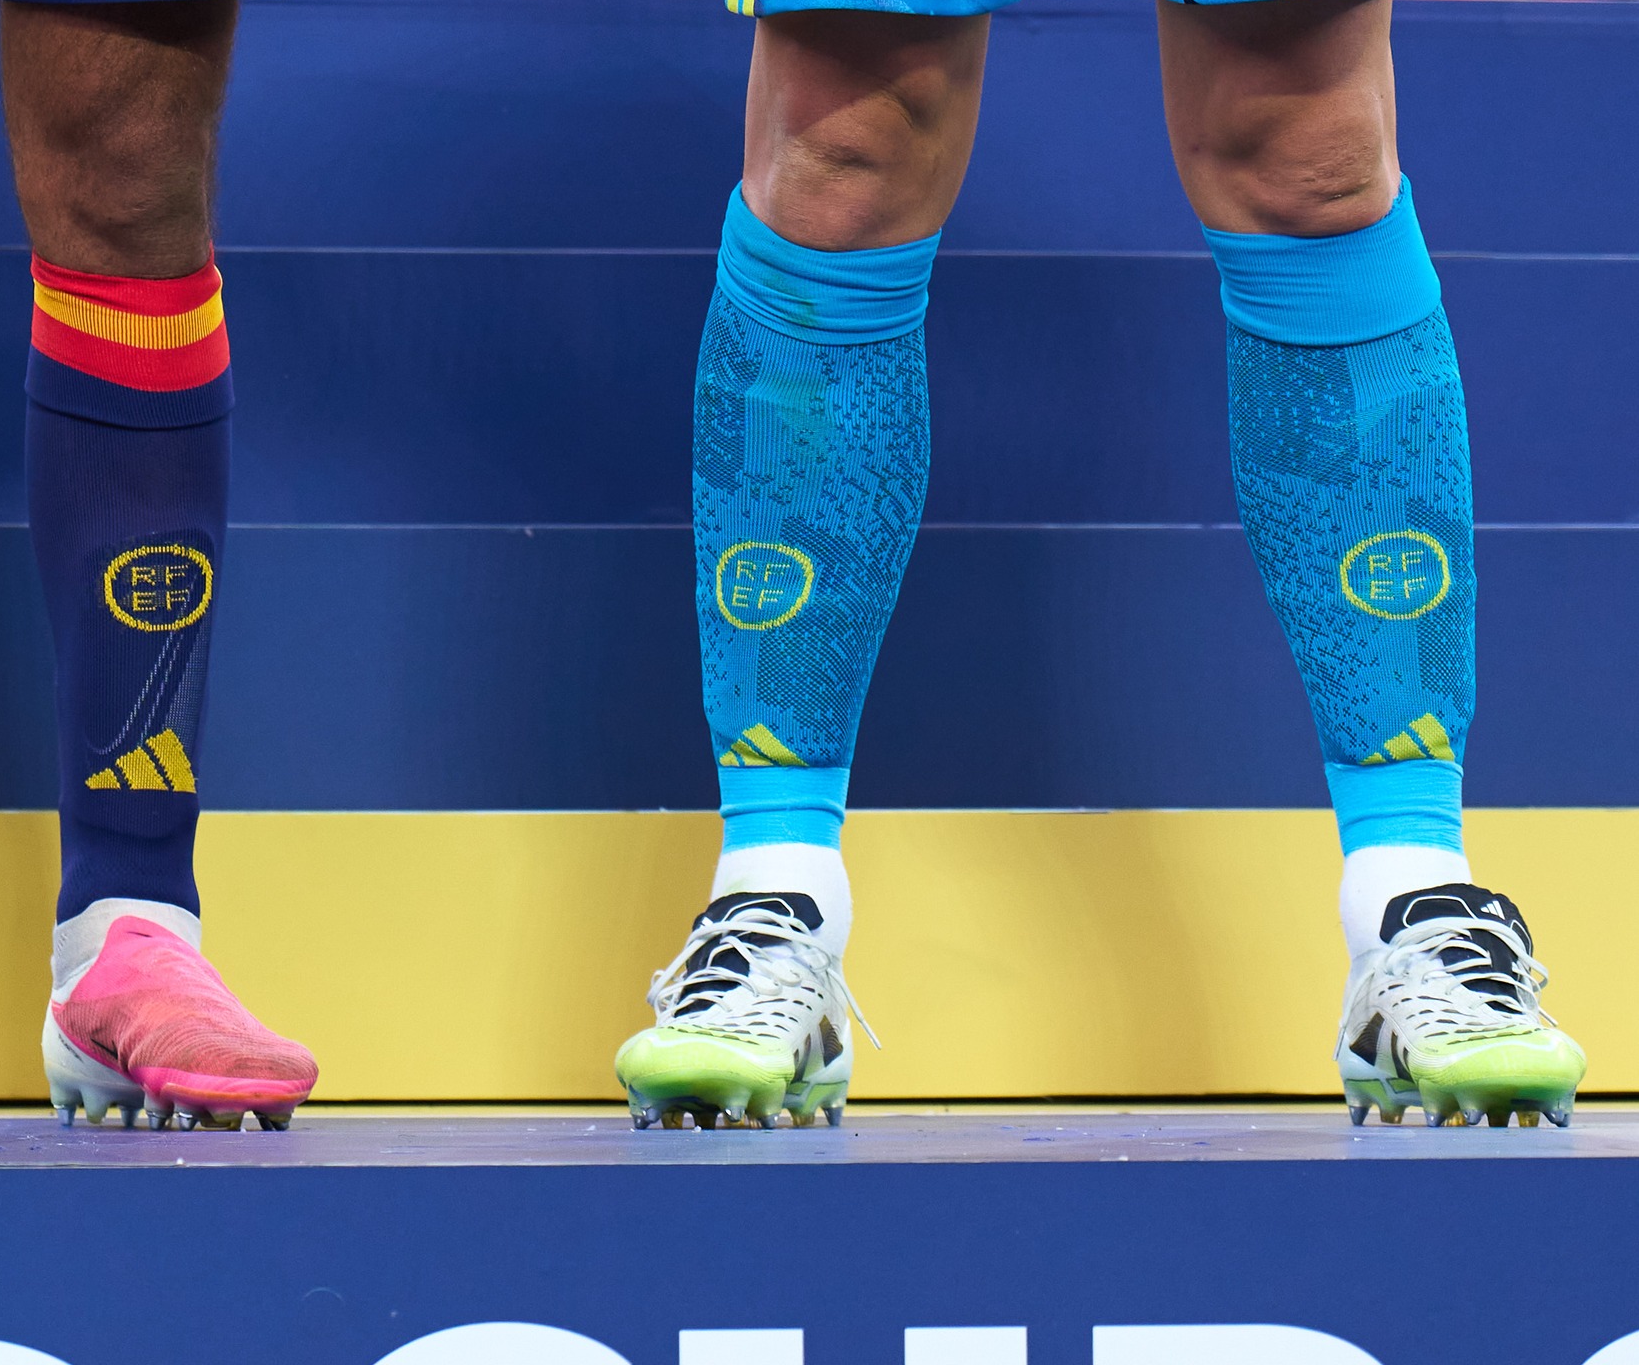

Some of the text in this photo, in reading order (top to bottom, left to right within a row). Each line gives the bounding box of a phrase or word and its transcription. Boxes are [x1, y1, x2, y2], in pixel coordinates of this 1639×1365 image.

[736, 559, 790, 582] RF
[1369, 550, 1424, 574] RF
[131, 565, 189, 586] RF
[132, 589, 189, 611] EF
[732, 586, 783, 609] EF
[1370, 577, 1426, 600] EF
